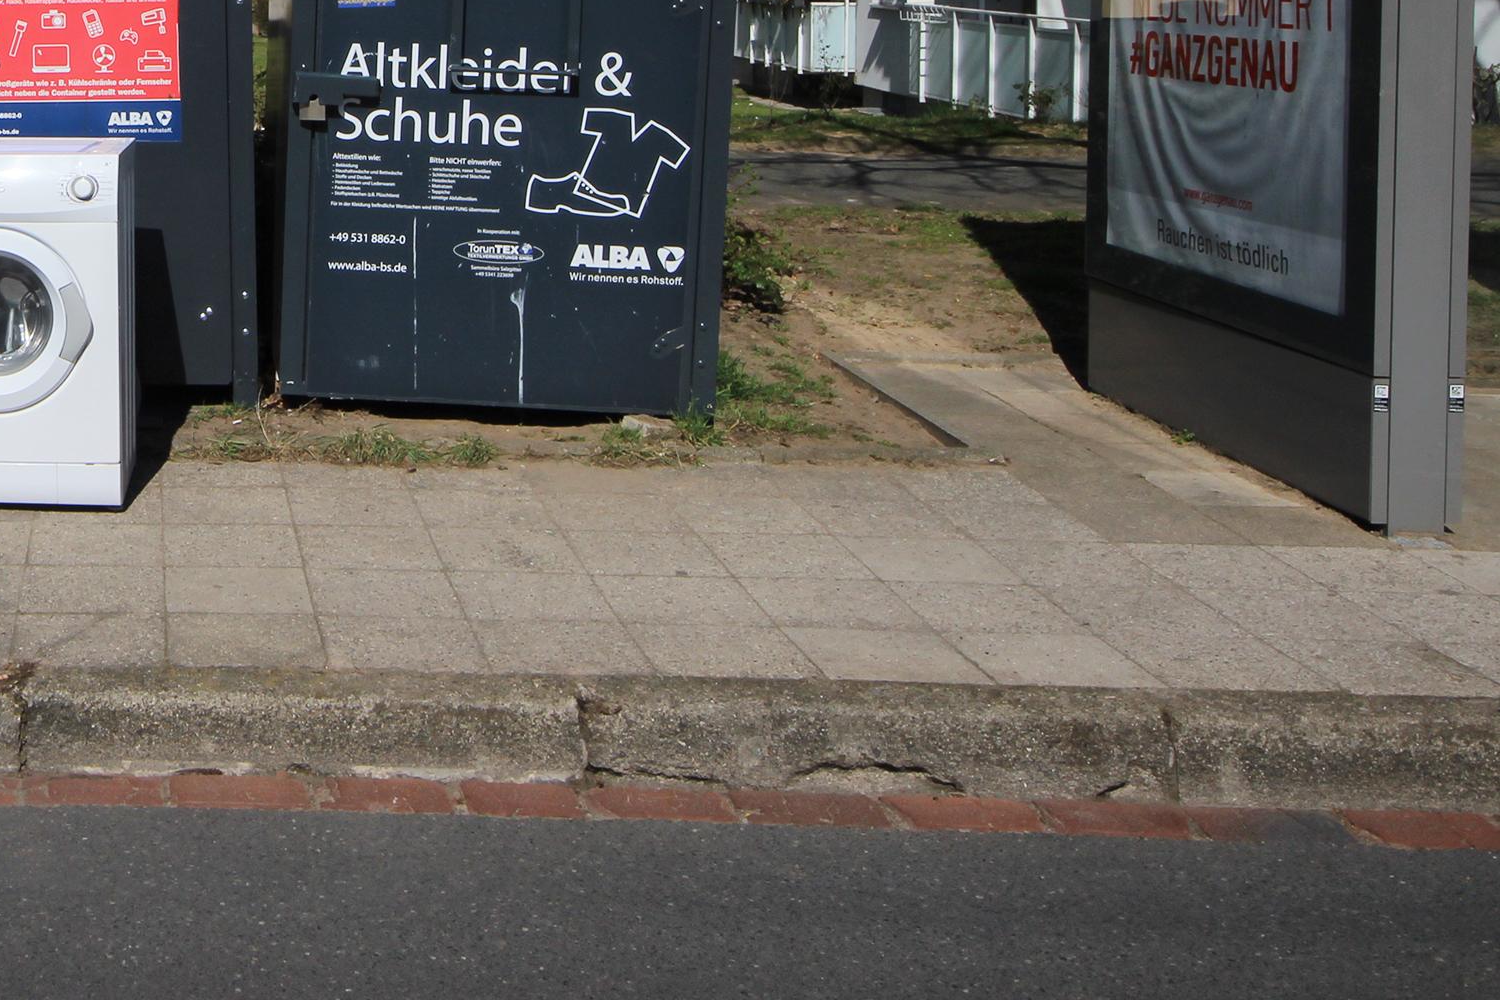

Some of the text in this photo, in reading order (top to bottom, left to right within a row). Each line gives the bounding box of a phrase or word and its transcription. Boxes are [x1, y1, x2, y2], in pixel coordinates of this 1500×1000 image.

[1130, 29, 1299, 93] #GANZGENAU
[341, 41, 632, 98] Altkleider &
[108, 111, 154, 126] ALBA
[335, 96, 522, 147] Schuhe
[429, 157, 444, 165] Bitte
[446, 157, 467, 165] NICHT
[329, 232, 406, 244] +49 531 8862-0
[468, 243, 519, 255] TorunTEX
[1157, 218, 1289, 276] Rauchen ist tödlich
[570, 244, 651, 270] ALBA
[328, 261, 407, 273] www.alba-bs.de
[569, 272, 683, 286] Wir nennen es Rohstoff.
